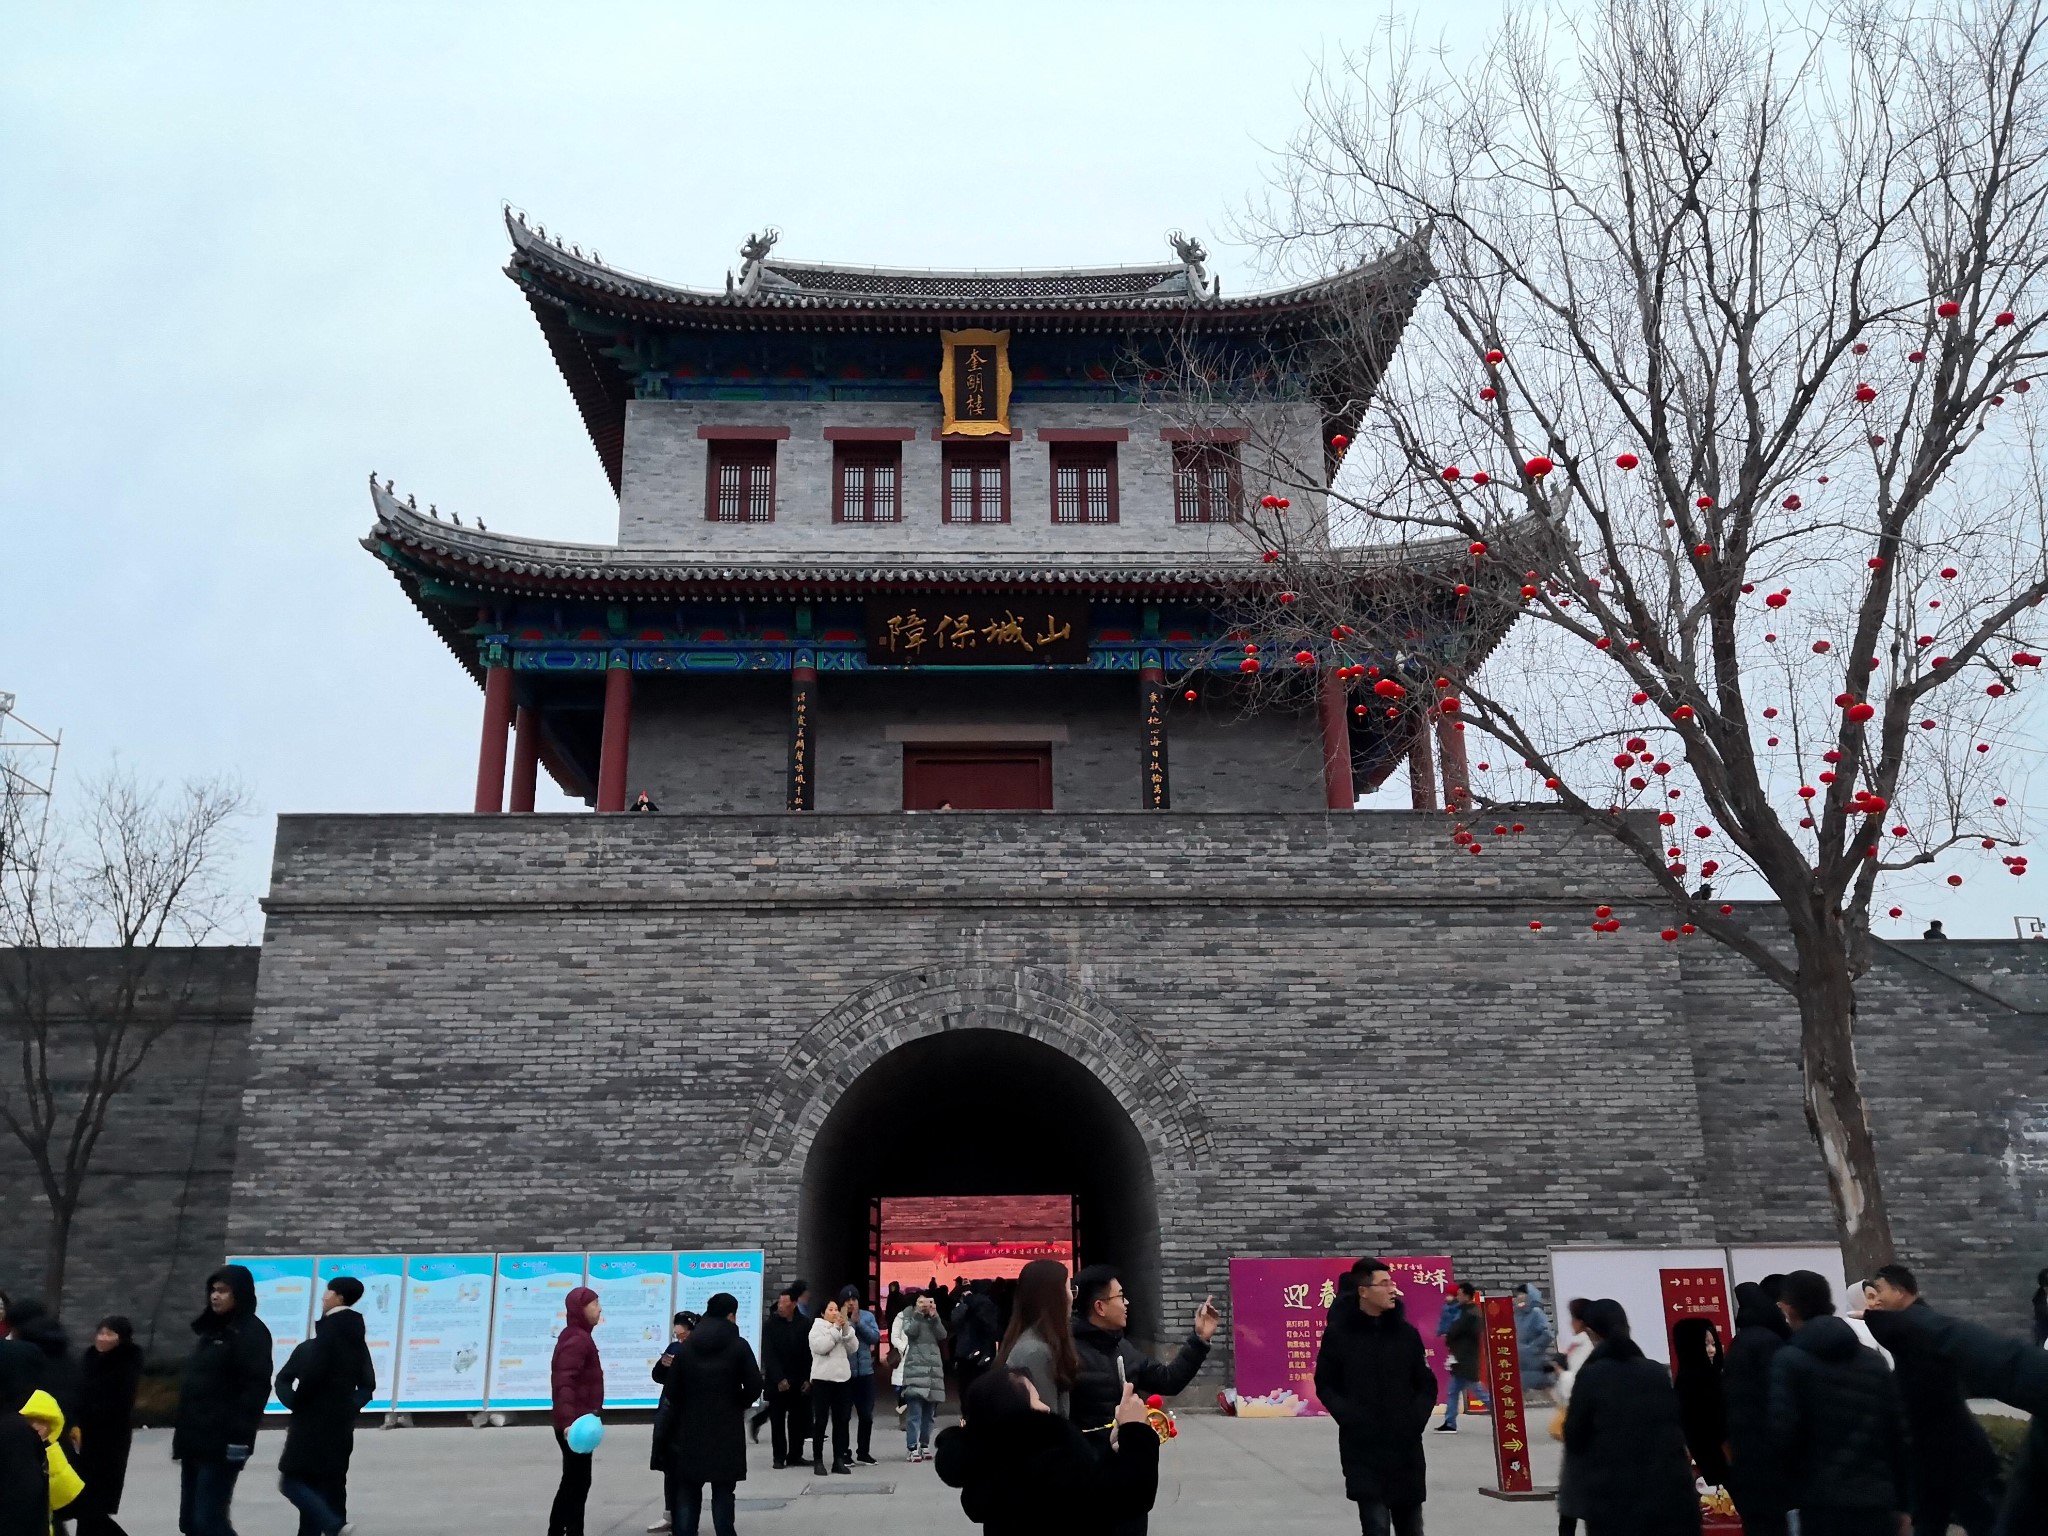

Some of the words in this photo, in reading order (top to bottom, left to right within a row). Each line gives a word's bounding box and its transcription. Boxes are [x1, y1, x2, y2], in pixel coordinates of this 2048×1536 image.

[1413, 1268, 1449, 1294] 过大年
[1496, 1346, 1519, 1434] 迎春灯会售票处
